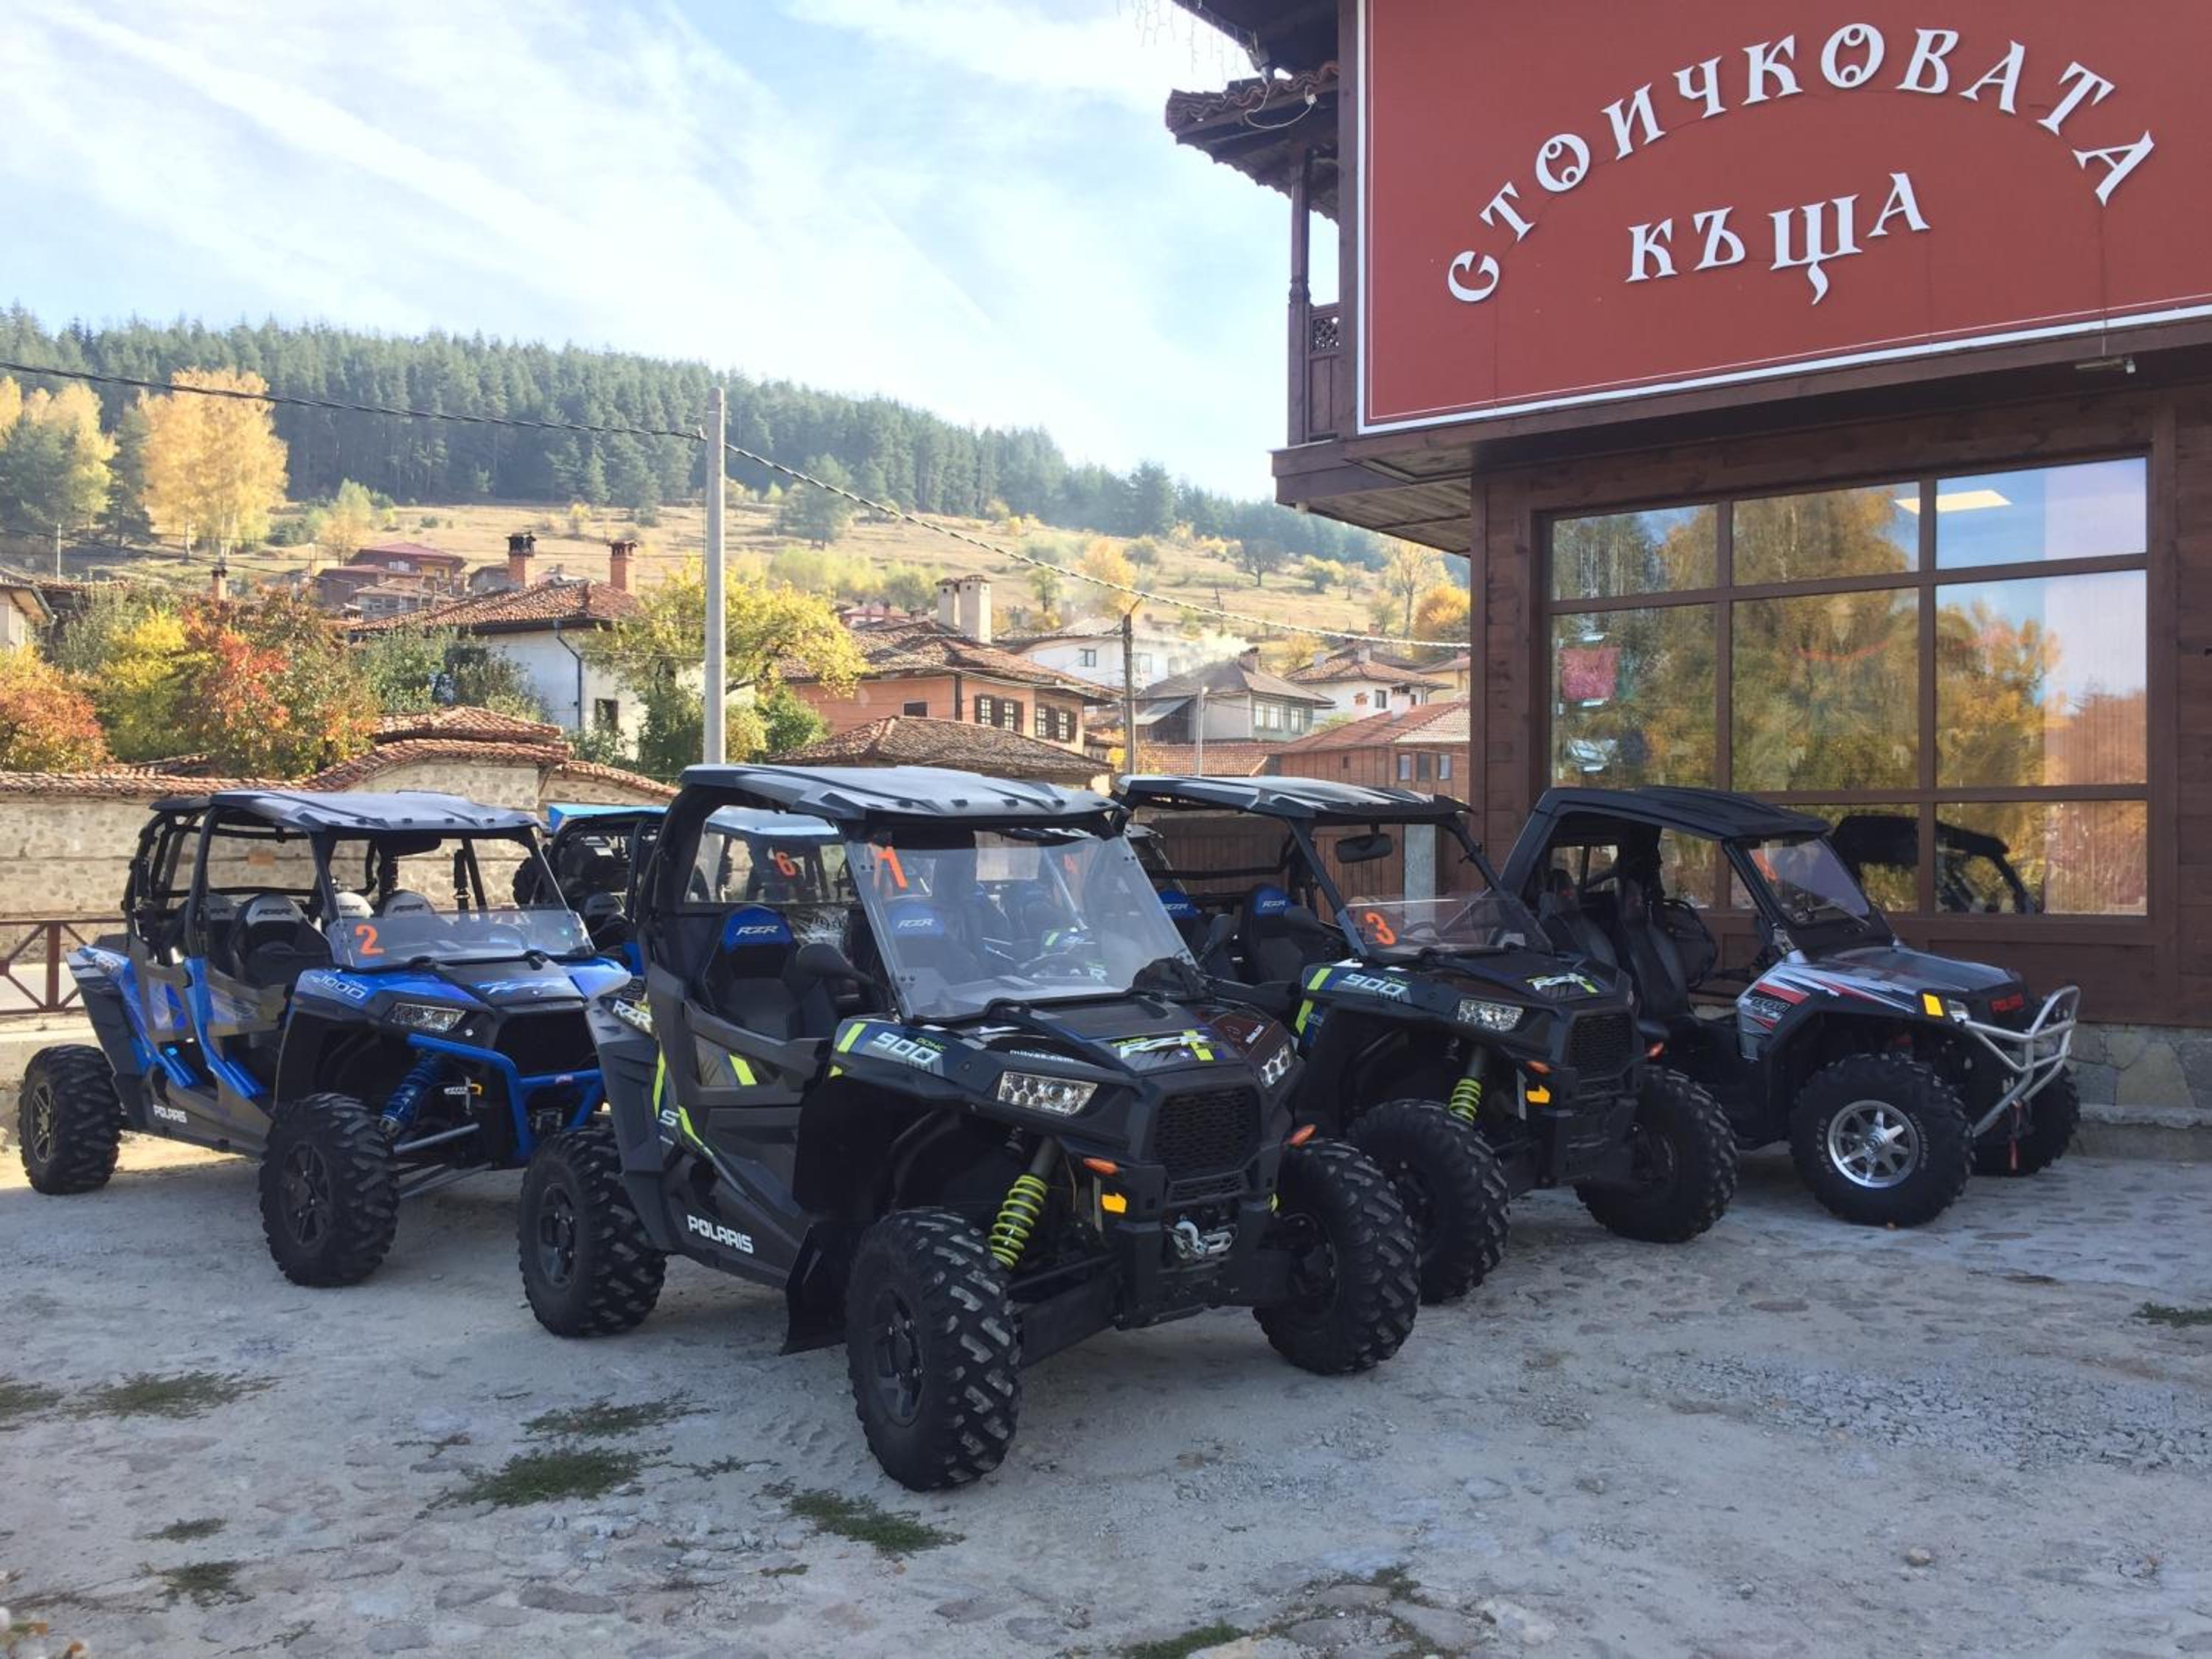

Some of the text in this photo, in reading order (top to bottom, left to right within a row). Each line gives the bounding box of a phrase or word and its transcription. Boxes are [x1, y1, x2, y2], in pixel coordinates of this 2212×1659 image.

[1447, 23, 2154, 302] СТОИЧКОВАТА
[1626, 172, 1930, 305] КЪЩА
[776, 850, 796, 876] 6
[355, 923, 384, 955] 2
[737, 925, 779, 936] RZR
[897, 919, 933, 929] RZR
[1366, 911, 1396, 945] 3
[1340, 973, 1408, 995] 900
[613, 999, 653, 1033] RZR
[872, 1032, 942, 1063] 900
[153, 1104, 187, 1123] POLARIS
[686, 1214, 754, 1254] POLARIS
